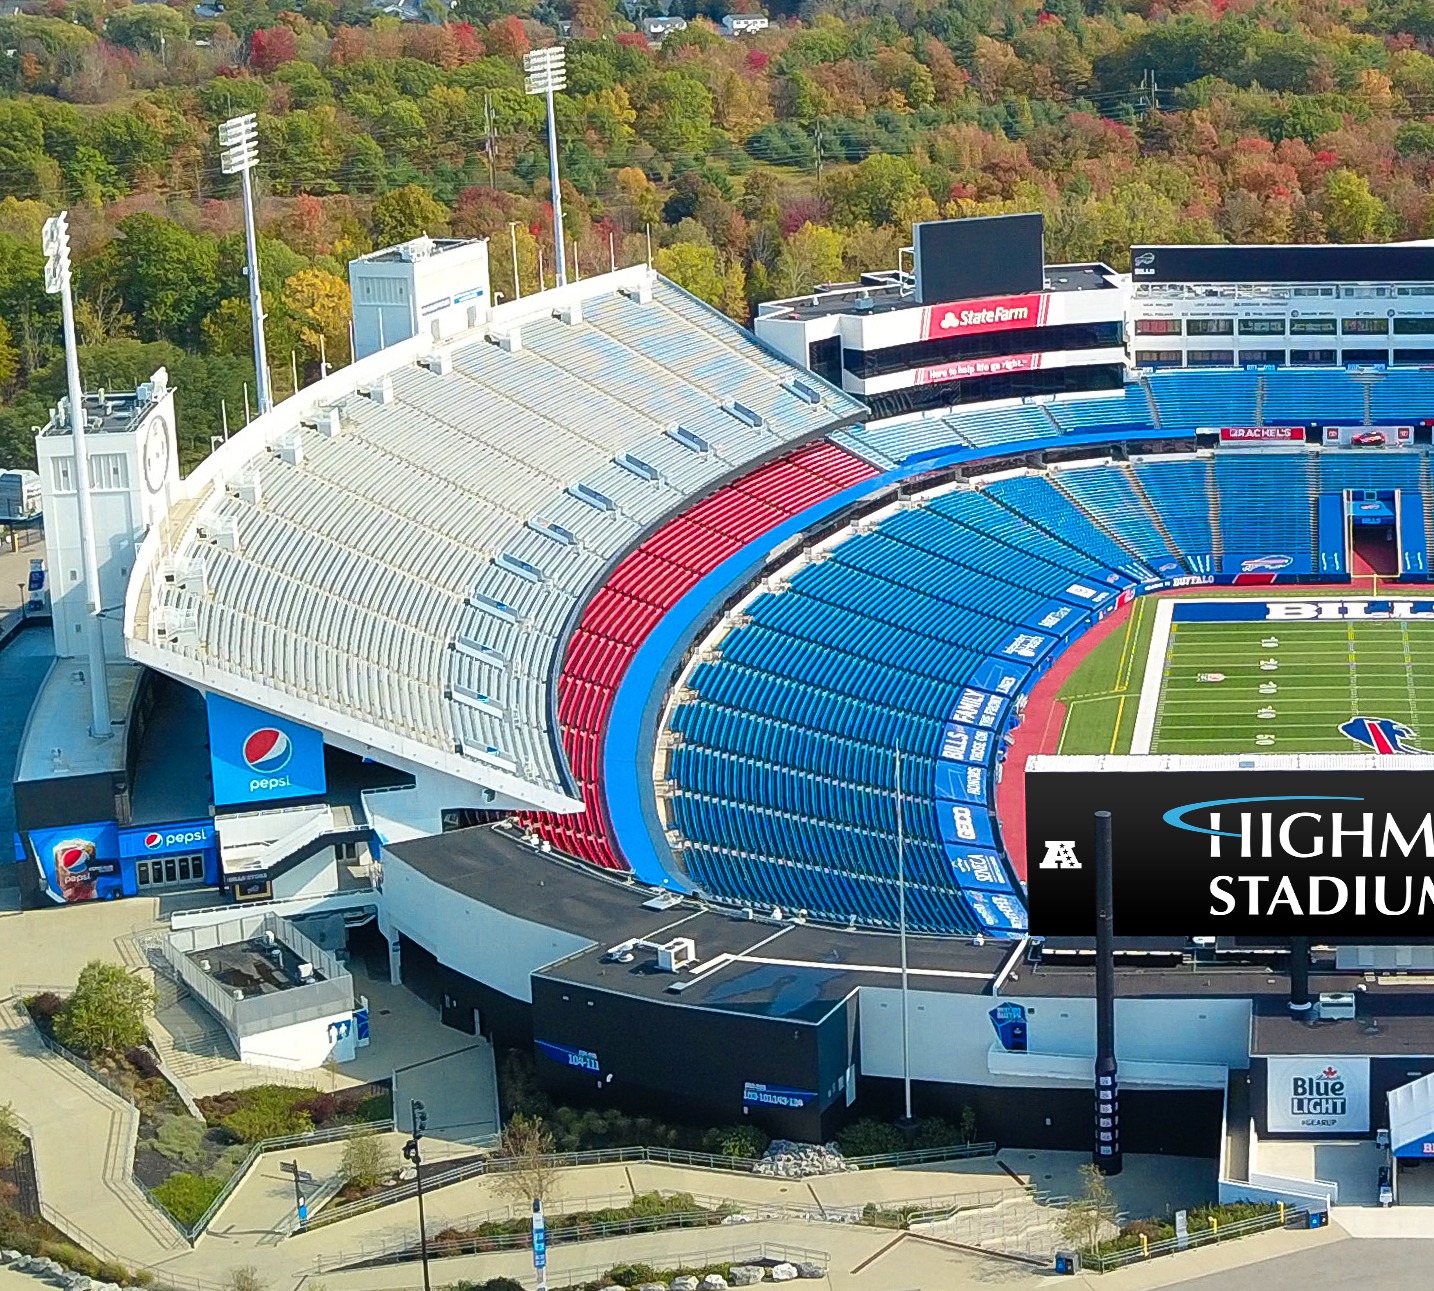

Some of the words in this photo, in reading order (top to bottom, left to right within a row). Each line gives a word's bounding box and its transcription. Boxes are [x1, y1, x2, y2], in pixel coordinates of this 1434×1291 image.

[250, 776, 291, 792] pepsi
[166, 829, 207, 846] pepsi
[1293, 1077, 1345, 1096] Blue
[1293, 1098, 1345, 1114] LIGHT
